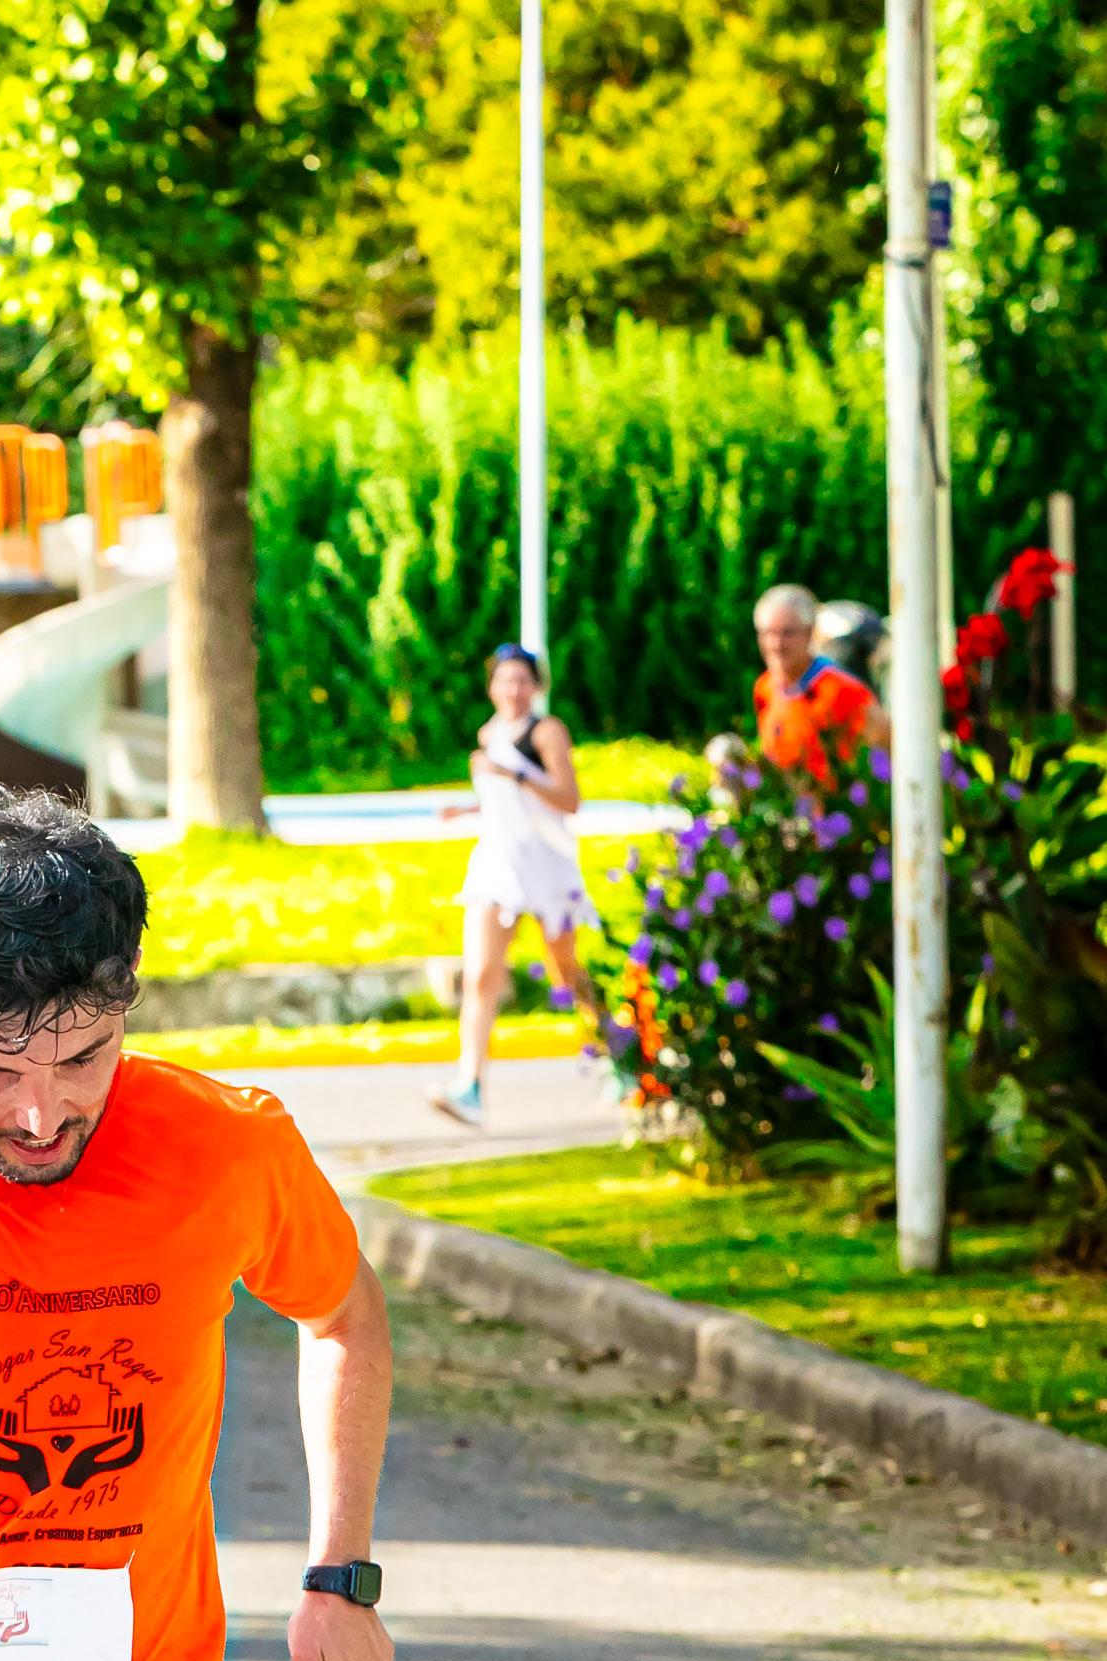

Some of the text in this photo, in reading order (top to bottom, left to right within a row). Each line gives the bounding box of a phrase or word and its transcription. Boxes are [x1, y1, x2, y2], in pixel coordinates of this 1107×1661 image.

[15, 1283, 160, 1313] ANIVERSARIO
[42, 1329, 92, 1359] San
[69, 1476, 121, 1515] 1975
[87, 1522, 144, 1542] Esperanza
